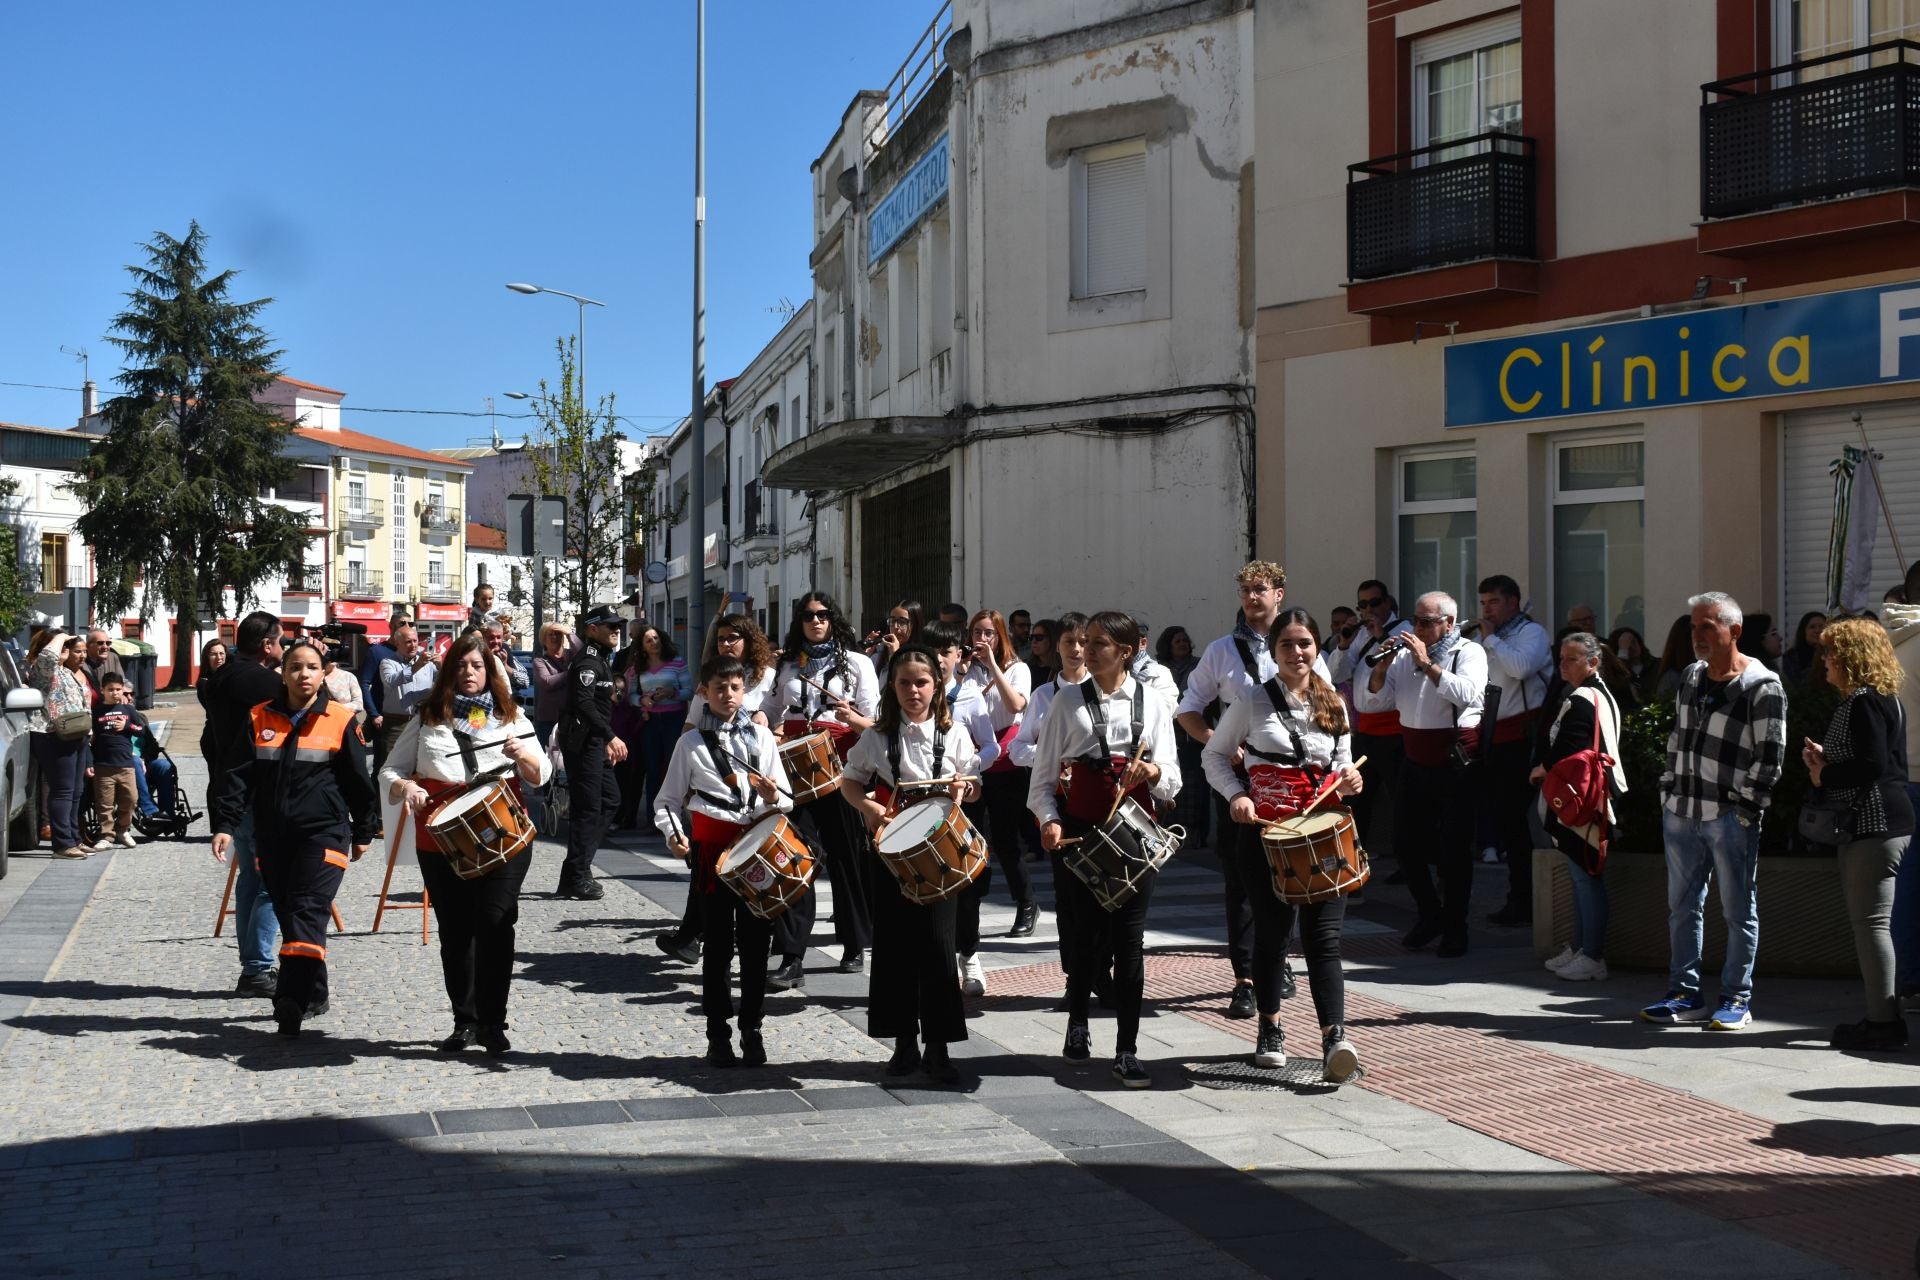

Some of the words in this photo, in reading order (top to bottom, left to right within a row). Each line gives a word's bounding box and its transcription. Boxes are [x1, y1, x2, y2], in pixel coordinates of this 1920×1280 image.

[870, 186, 905, 256] CINEMA
[907, 145, 948, 218] OTERO
[1499, 326, 1810, 414] Clínica
